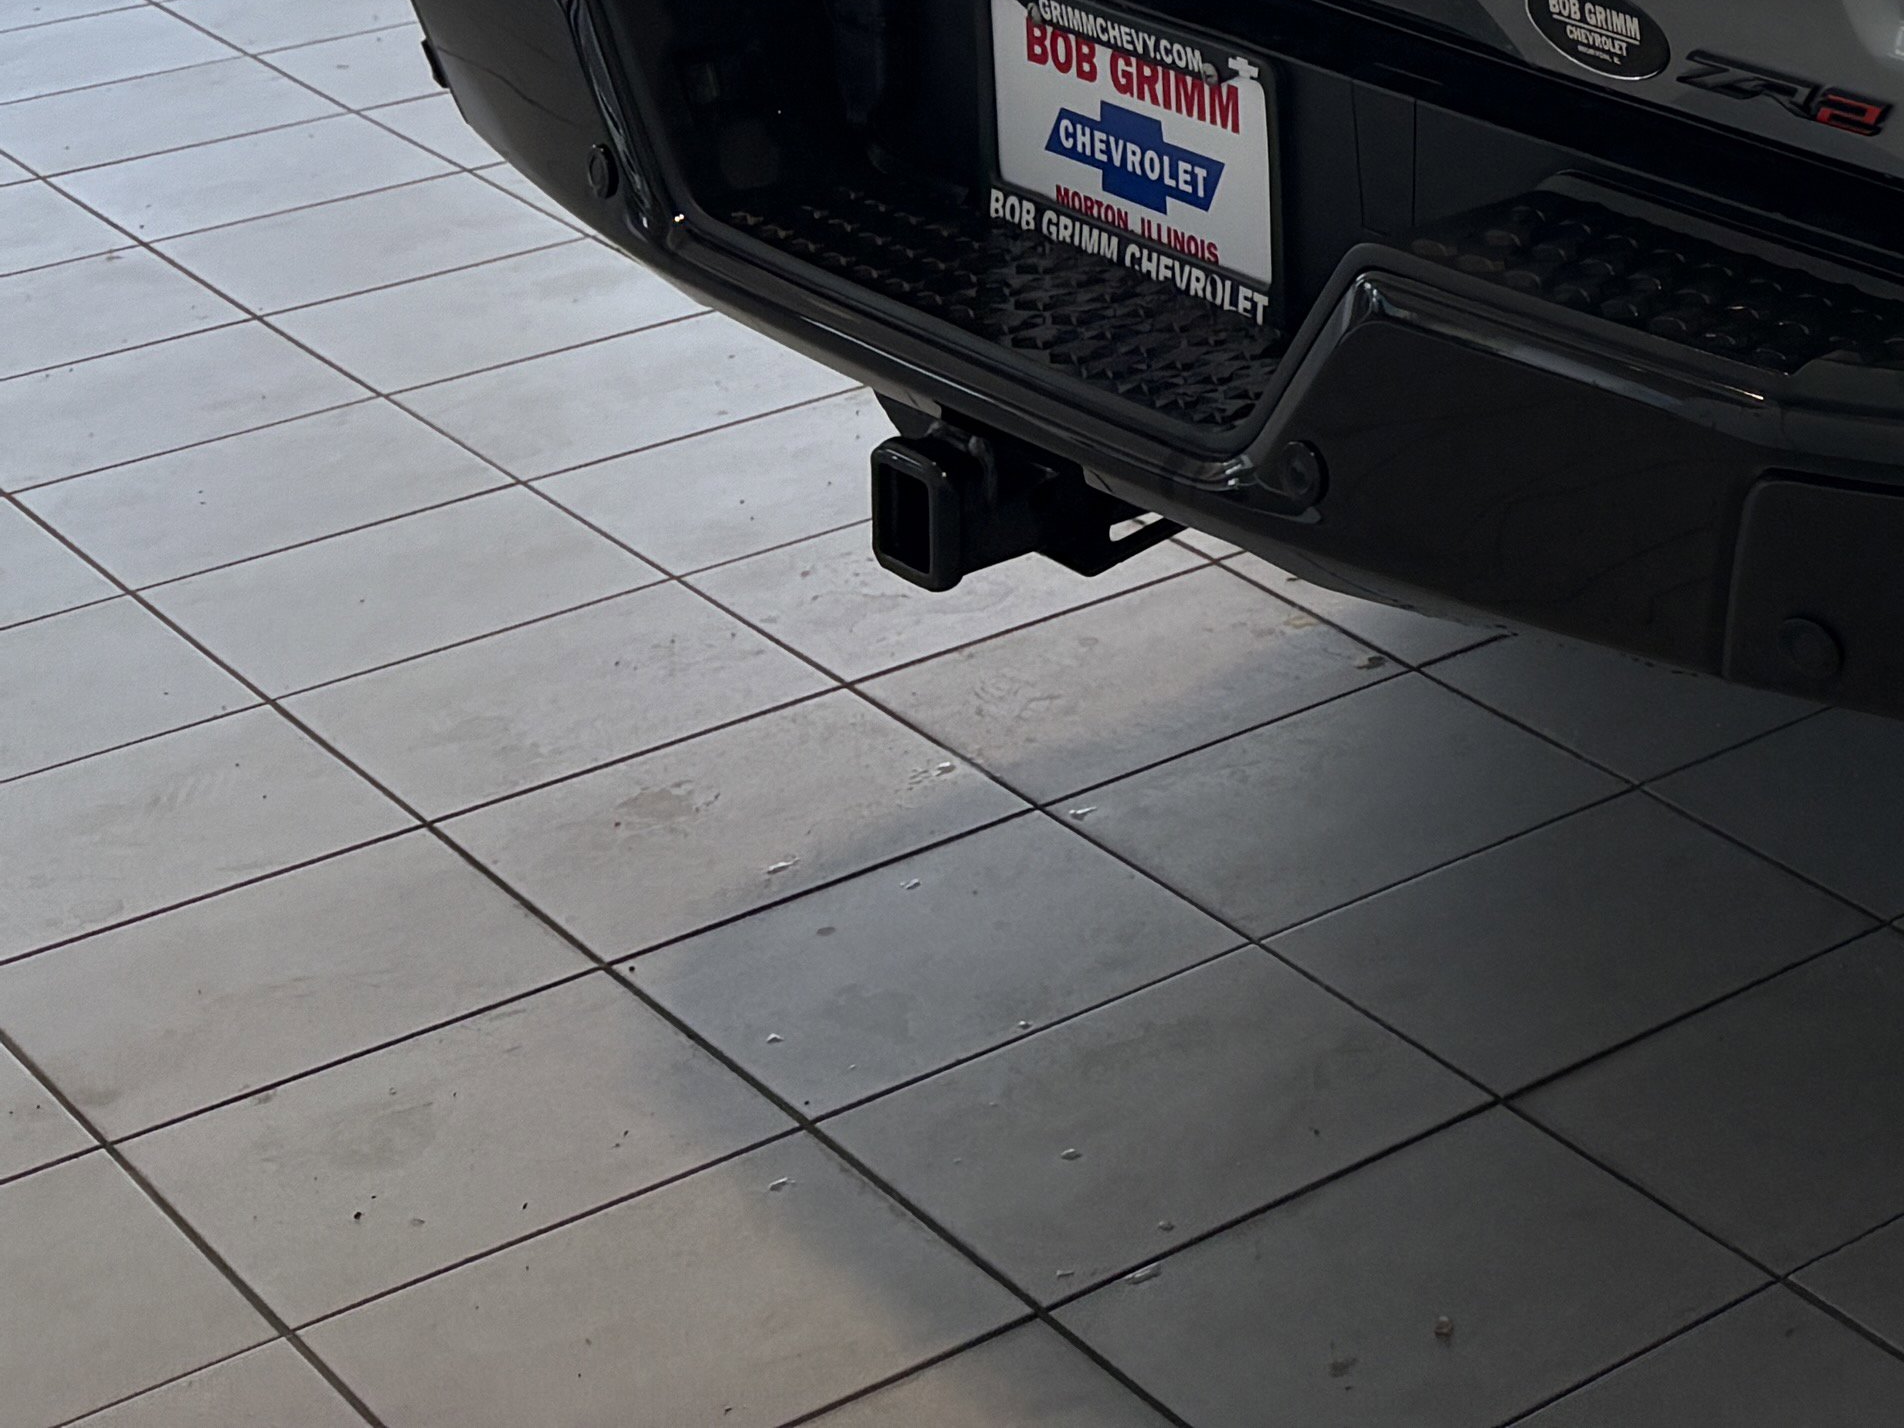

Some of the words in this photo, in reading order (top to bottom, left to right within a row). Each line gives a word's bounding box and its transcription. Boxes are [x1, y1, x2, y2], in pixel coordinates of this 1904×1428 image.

[1565, 24, 1627, 57] CHEVROLET
[1584, 2, 1641, 41] GRIMM
[1026, 14, 1098, 83] BOB
[1109, 49, 1240, 135] GRIMM
[1675, 49, 1896, 137] ZR2
[1059, 117, 1207, 198] CHEVROLET
[989, 188, 1036, 231] BOB
[1041, 209, 1119, 264] GRIMM
[1124, 243, 1269, 326] CHEVROLET
[1140, 216, 1219, 266] ILLINOIS
